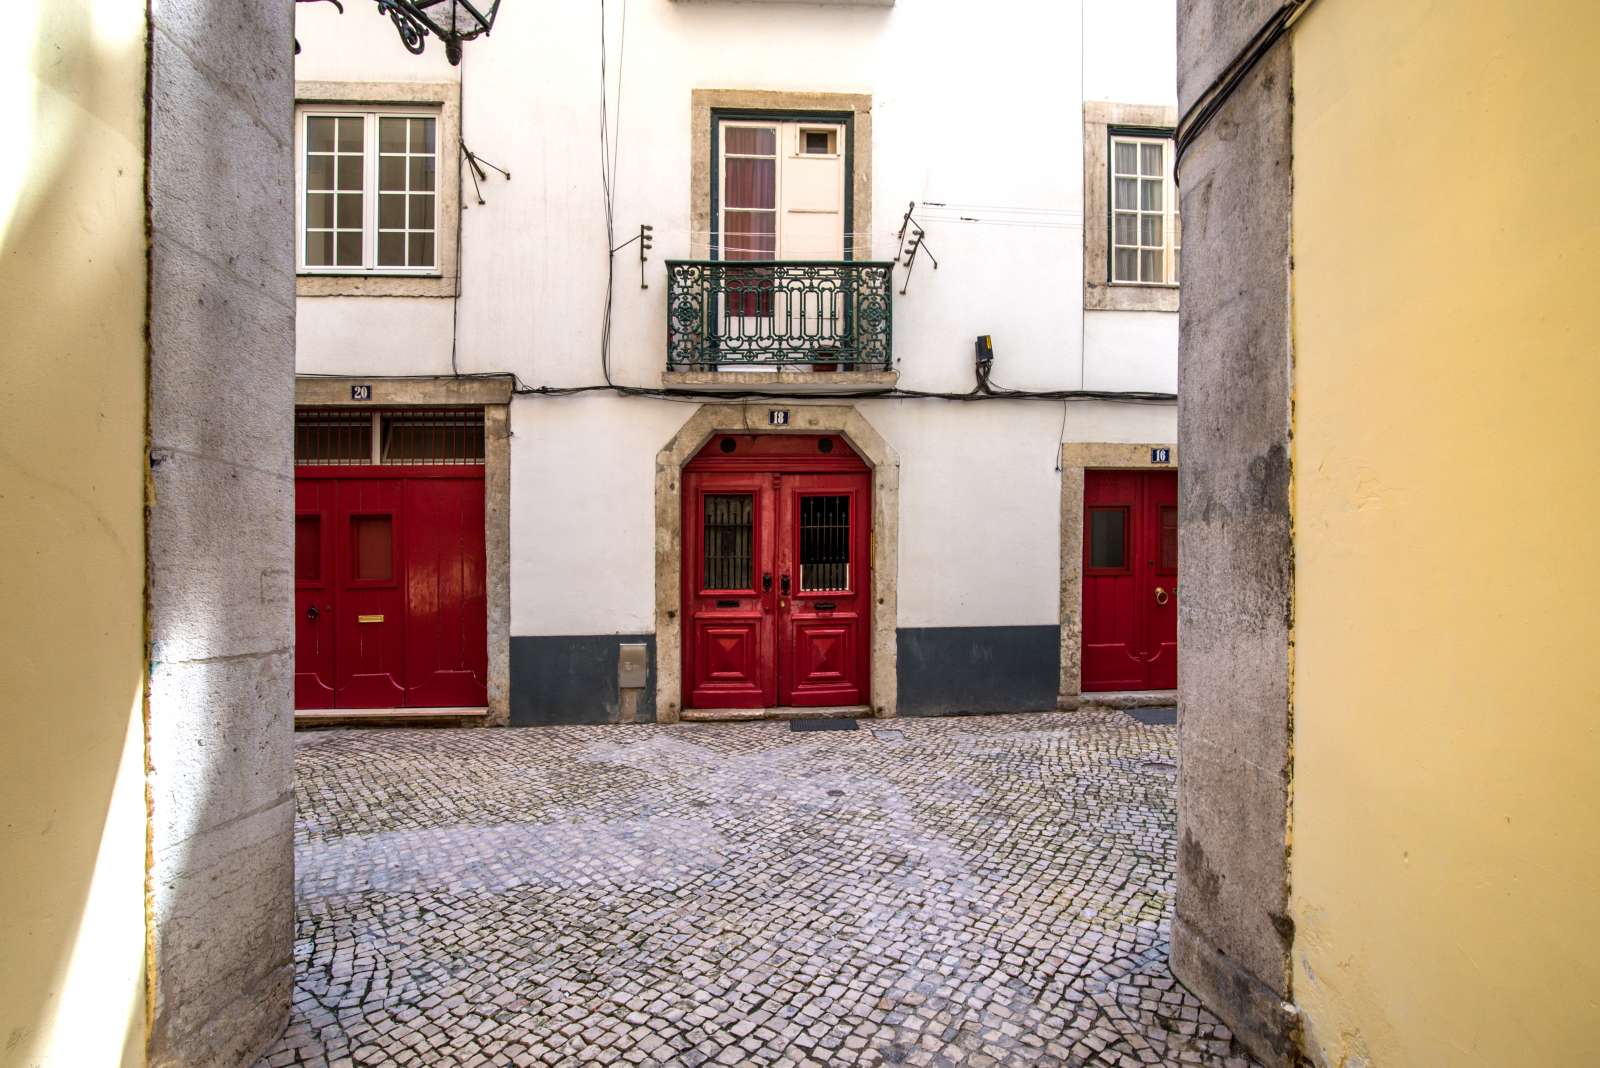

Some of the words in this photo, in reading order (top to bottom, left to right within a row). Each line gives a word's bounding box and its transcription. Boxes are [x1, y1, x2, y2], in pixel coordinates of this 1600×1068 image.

[354, 386, 368, 399] 20
[774, 411, 784, 424] 18
[1156, 449, 1166, 461] 16
